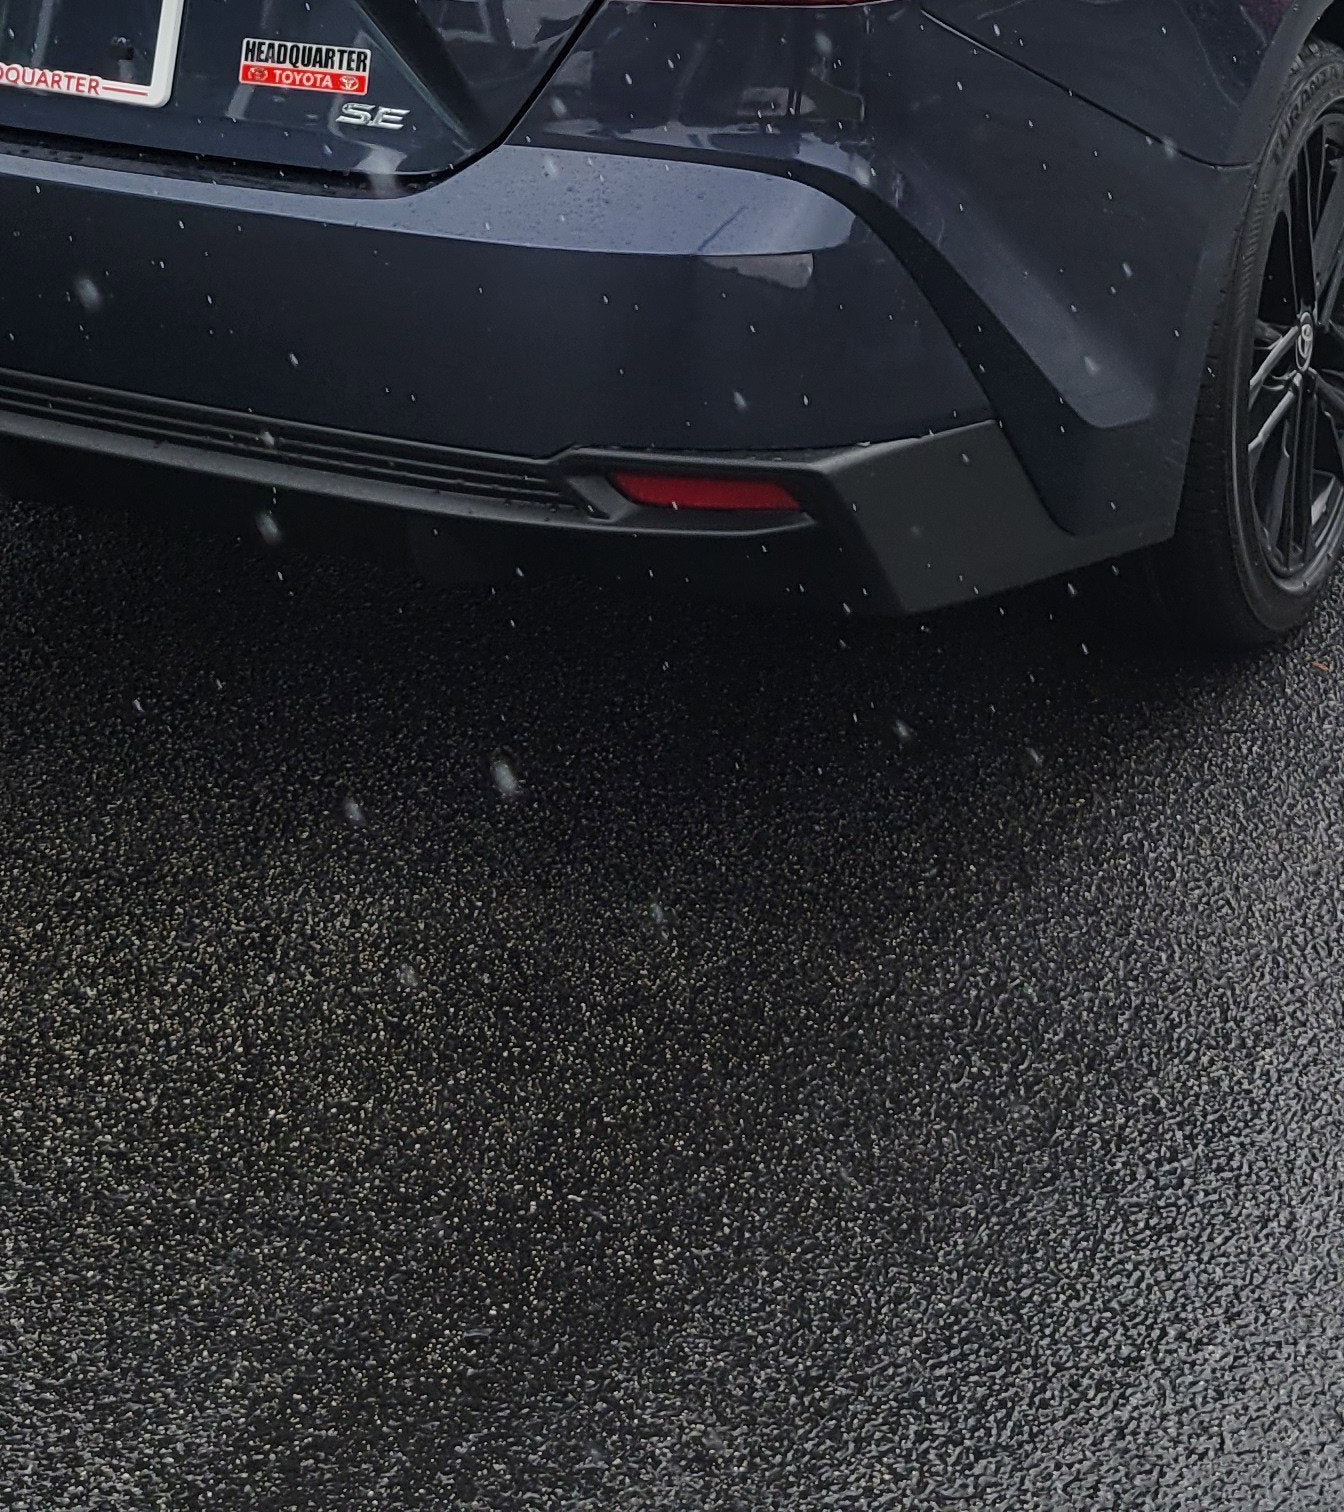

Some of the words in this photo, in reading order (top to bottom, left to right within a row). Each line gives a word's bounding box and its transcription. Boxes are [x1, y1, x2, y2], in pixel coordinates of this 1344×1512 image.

[244, 39, 369, 73] HEADQUARTER
[273, 68, 334, 89] TOYOTA
[335, 102, 411, 131] SE
